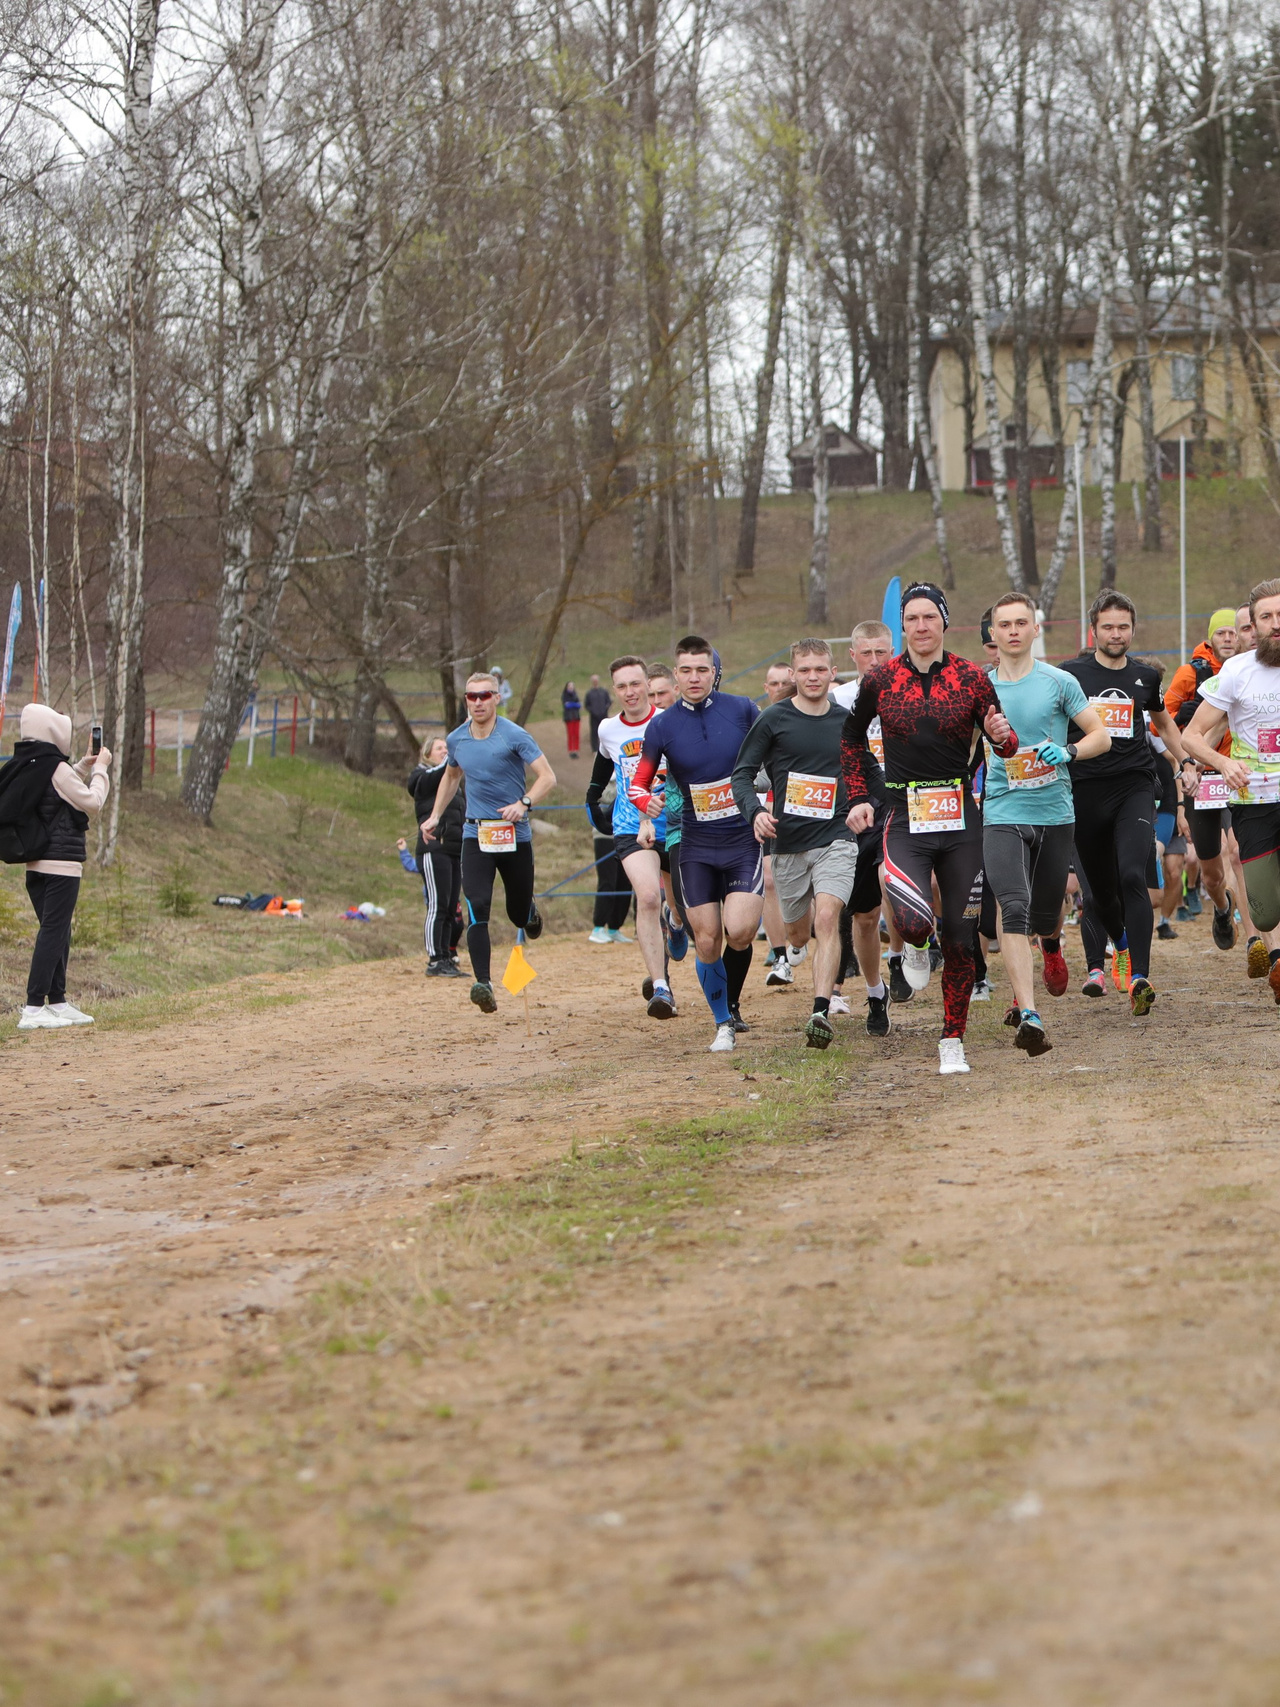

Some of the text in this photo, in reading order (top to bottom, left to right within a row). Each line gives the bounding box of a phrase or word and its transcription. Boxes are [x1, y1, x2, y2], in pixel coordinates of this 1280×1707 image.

[1104, 709, 1129, 722] 214
[915, 779, 955, 787] POWERUP
[707, 788, 733, 806] 244
[803, 787, 832, 803] 242
[928, 797, 958, 814] 248
[490, 829, 512, 841] 256
